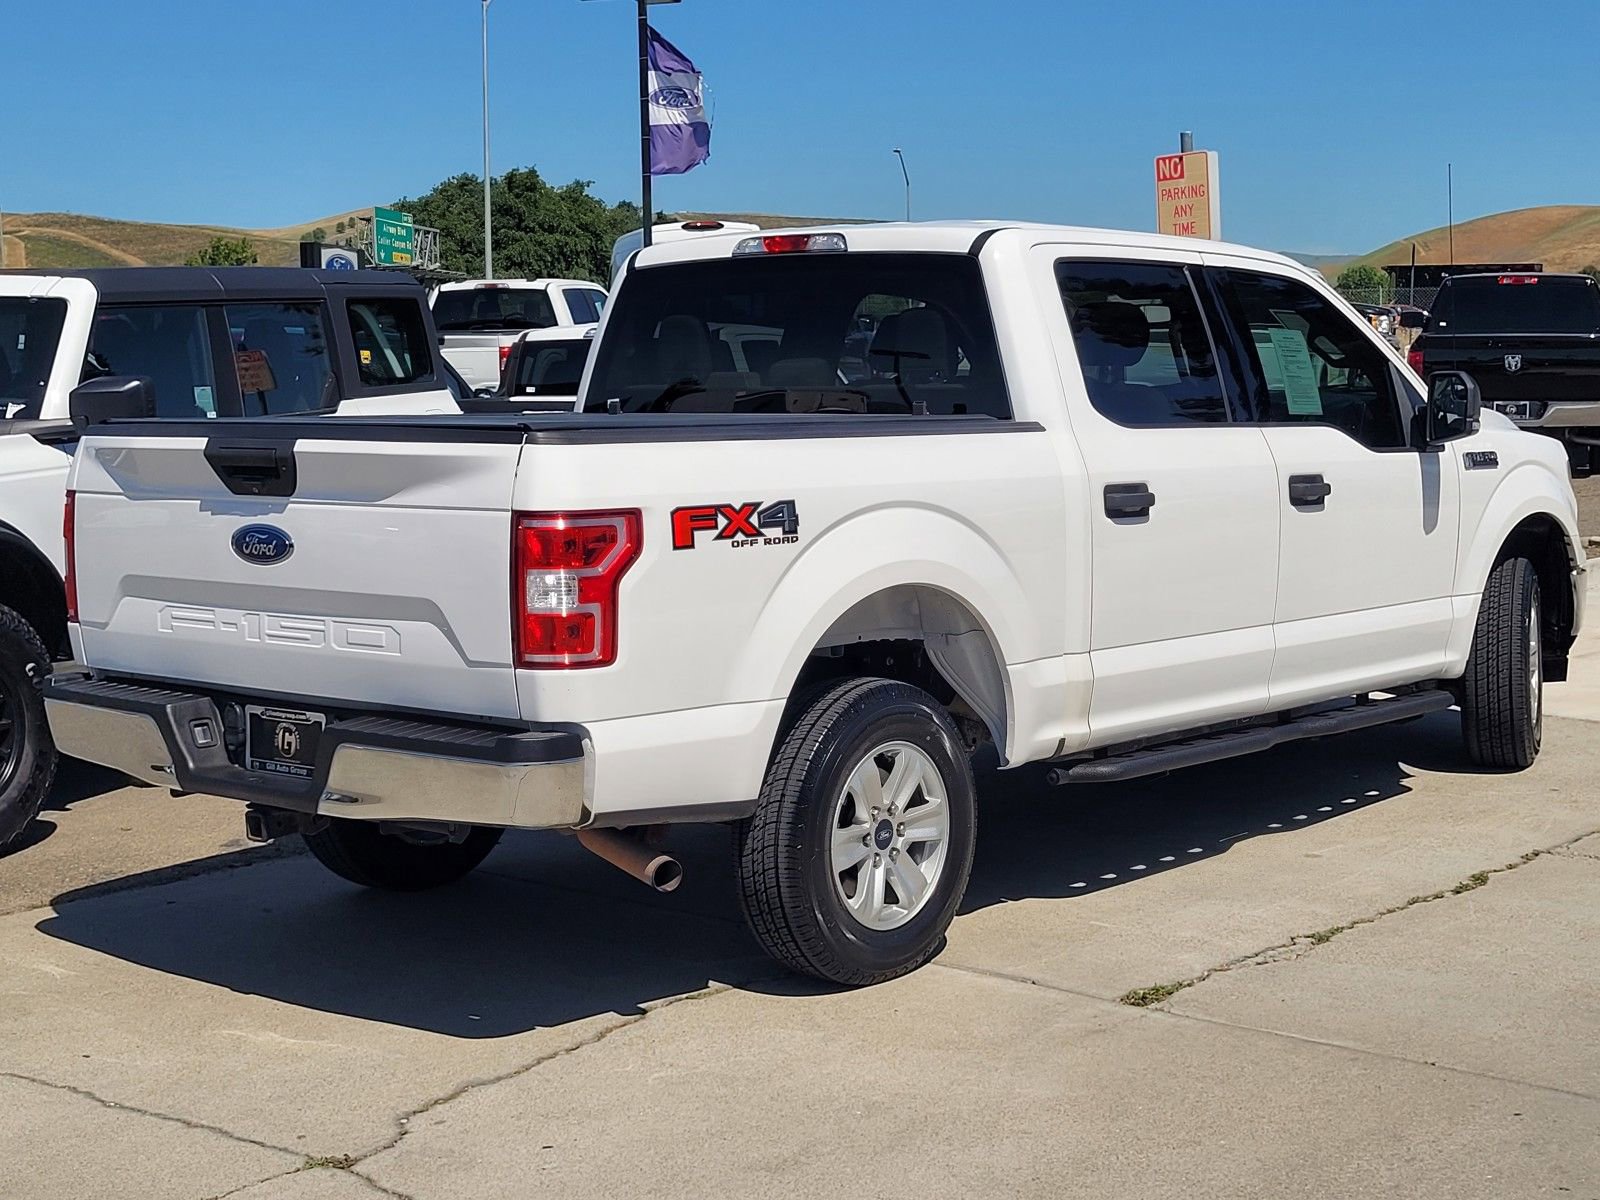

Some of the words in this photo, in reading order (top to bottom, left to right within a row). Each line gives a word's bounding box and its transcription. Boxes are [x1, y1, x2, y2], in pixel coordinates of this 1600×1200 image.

[1159, 158, 1181, 180] NO
[1161, 184, 1205, 201] PARKING
[1173, 204, 1194, 218] ANY
[1173, 222, 1196, 236] TIME
[670, 499, 799, 551] FX4
[243, 532, 277, 556] Ford
[731, 539, 759, 549] OFF
[763, 535, 799, 546] ROAD
[157, 604, 402, 657] F-150
